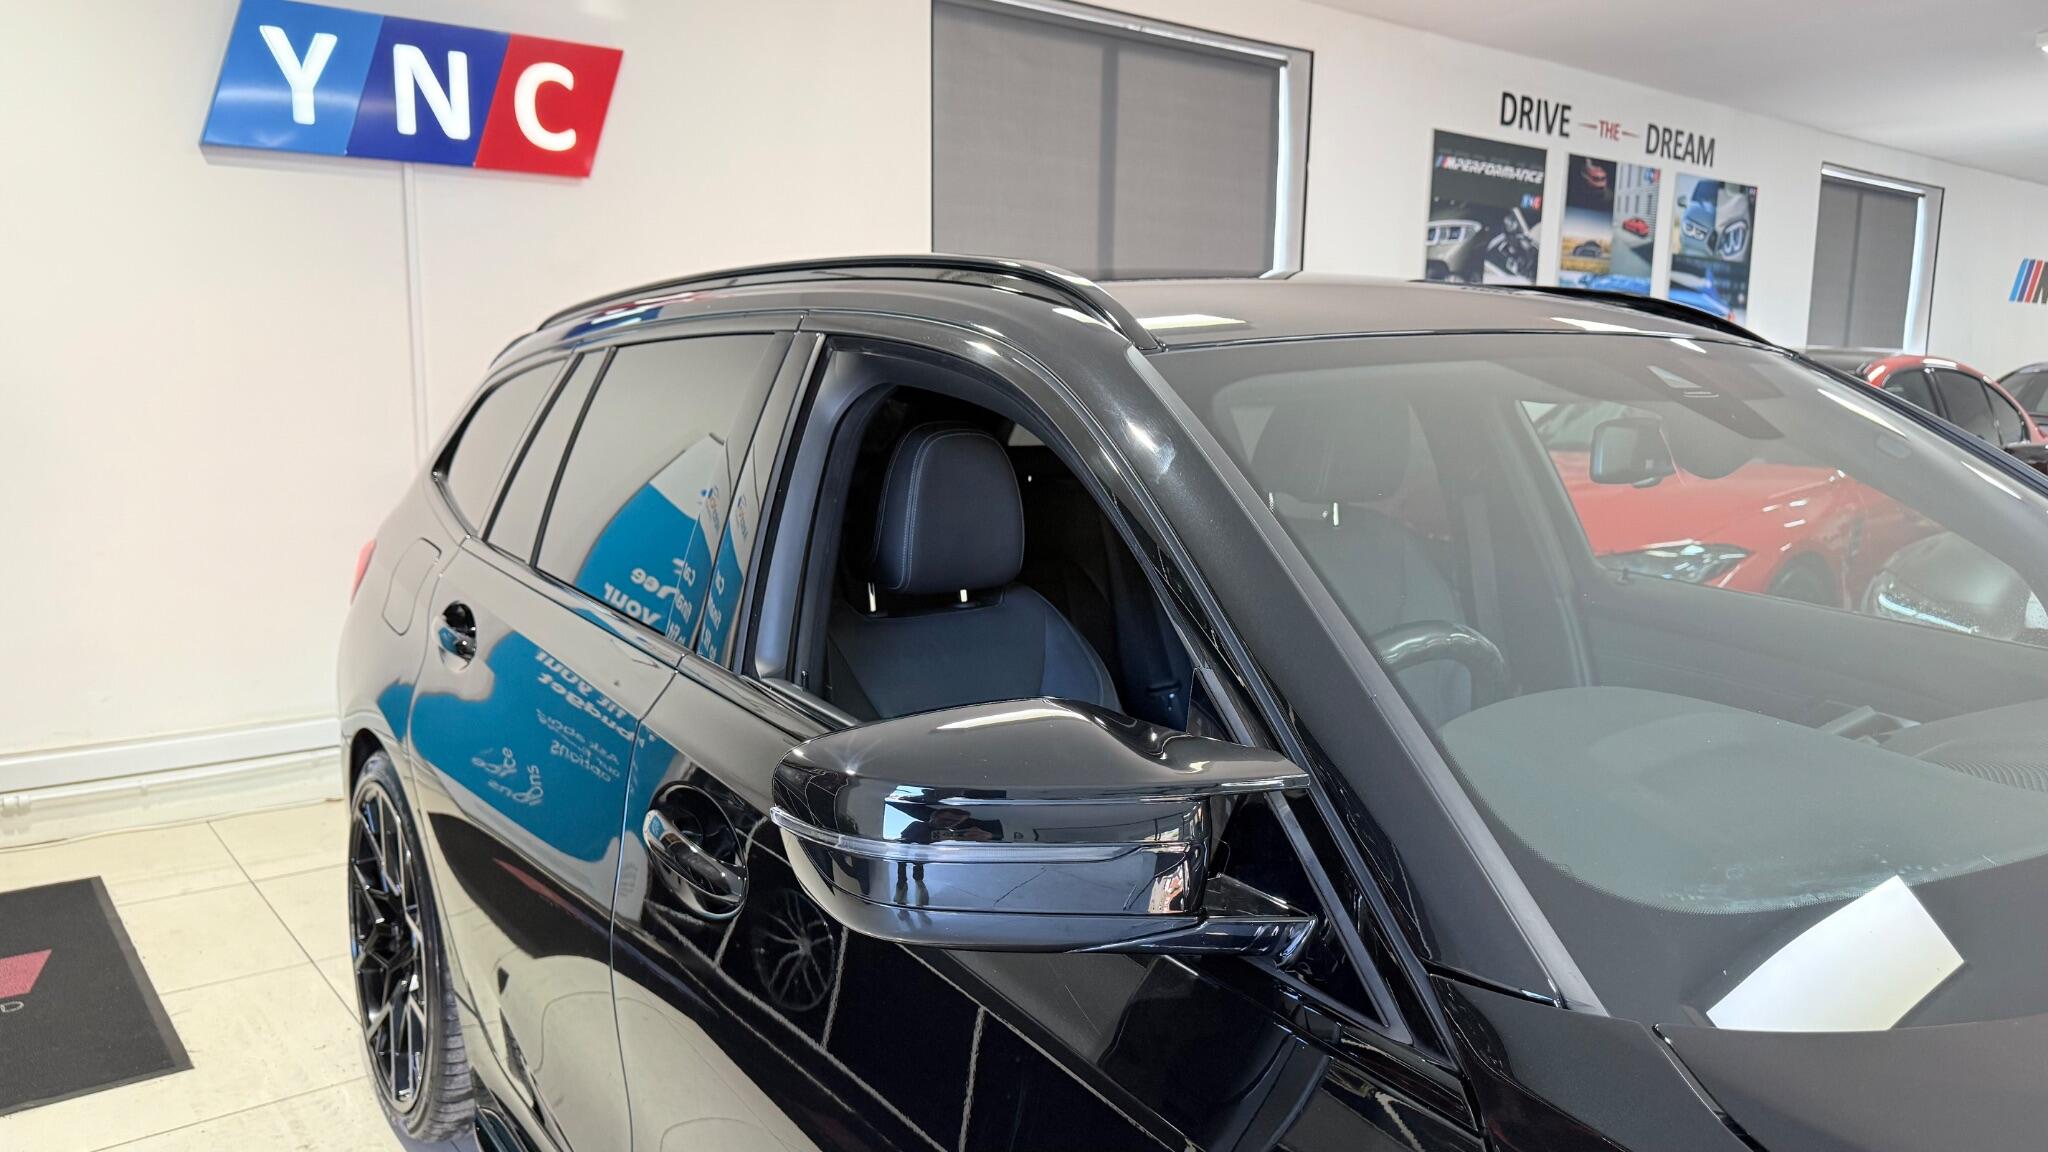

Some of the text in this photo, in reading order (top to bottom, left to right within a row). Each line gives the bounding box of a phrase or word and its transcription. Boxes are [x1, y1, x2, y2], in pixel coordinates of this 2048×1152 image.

[258, 24, 577, 152] YNC
[1500, 91, 1716, 167] DRIVE THE DREAM
